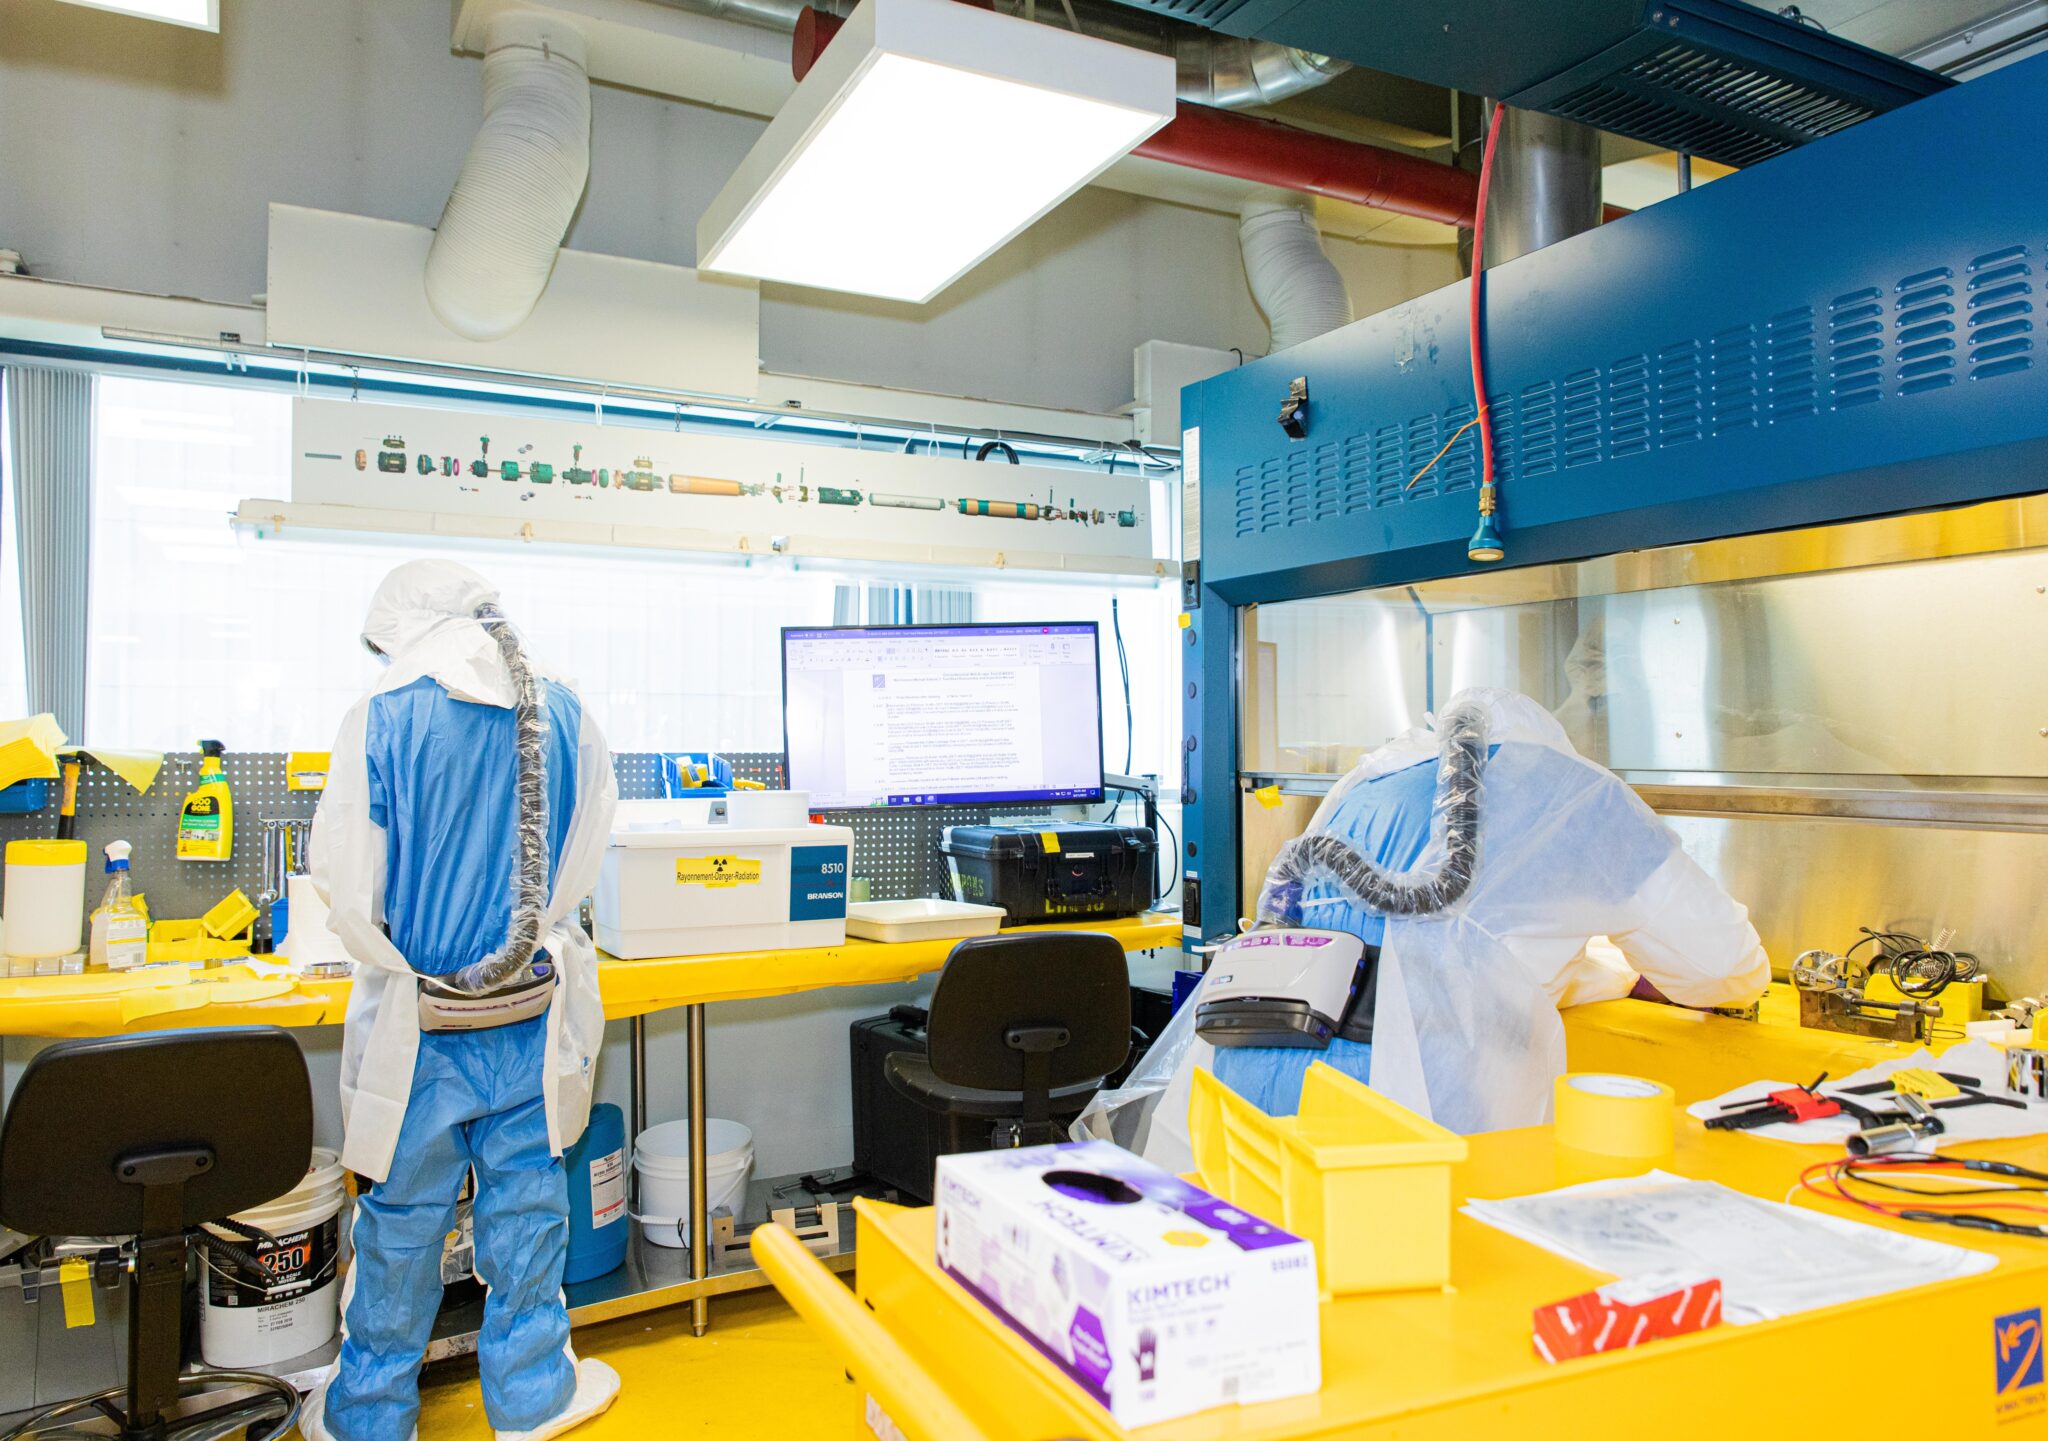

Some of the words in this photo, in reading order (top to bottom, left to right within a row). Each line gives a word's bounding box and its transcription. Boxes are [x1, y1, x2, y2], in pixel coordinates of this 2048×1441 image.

[192, 797, 211, 805] GOO
[821, 862, 845, 875] 8510
[676, 870, 760, 883] Rayonnement-Danger-Radiation
[807, 891, 844, 900] BRANSON
[264, 1247, 304, 1274] 250
[1128, 1272, 1230, 1303] KIMTECH
[257, 1301, 294, 1312] MIRACHEM
